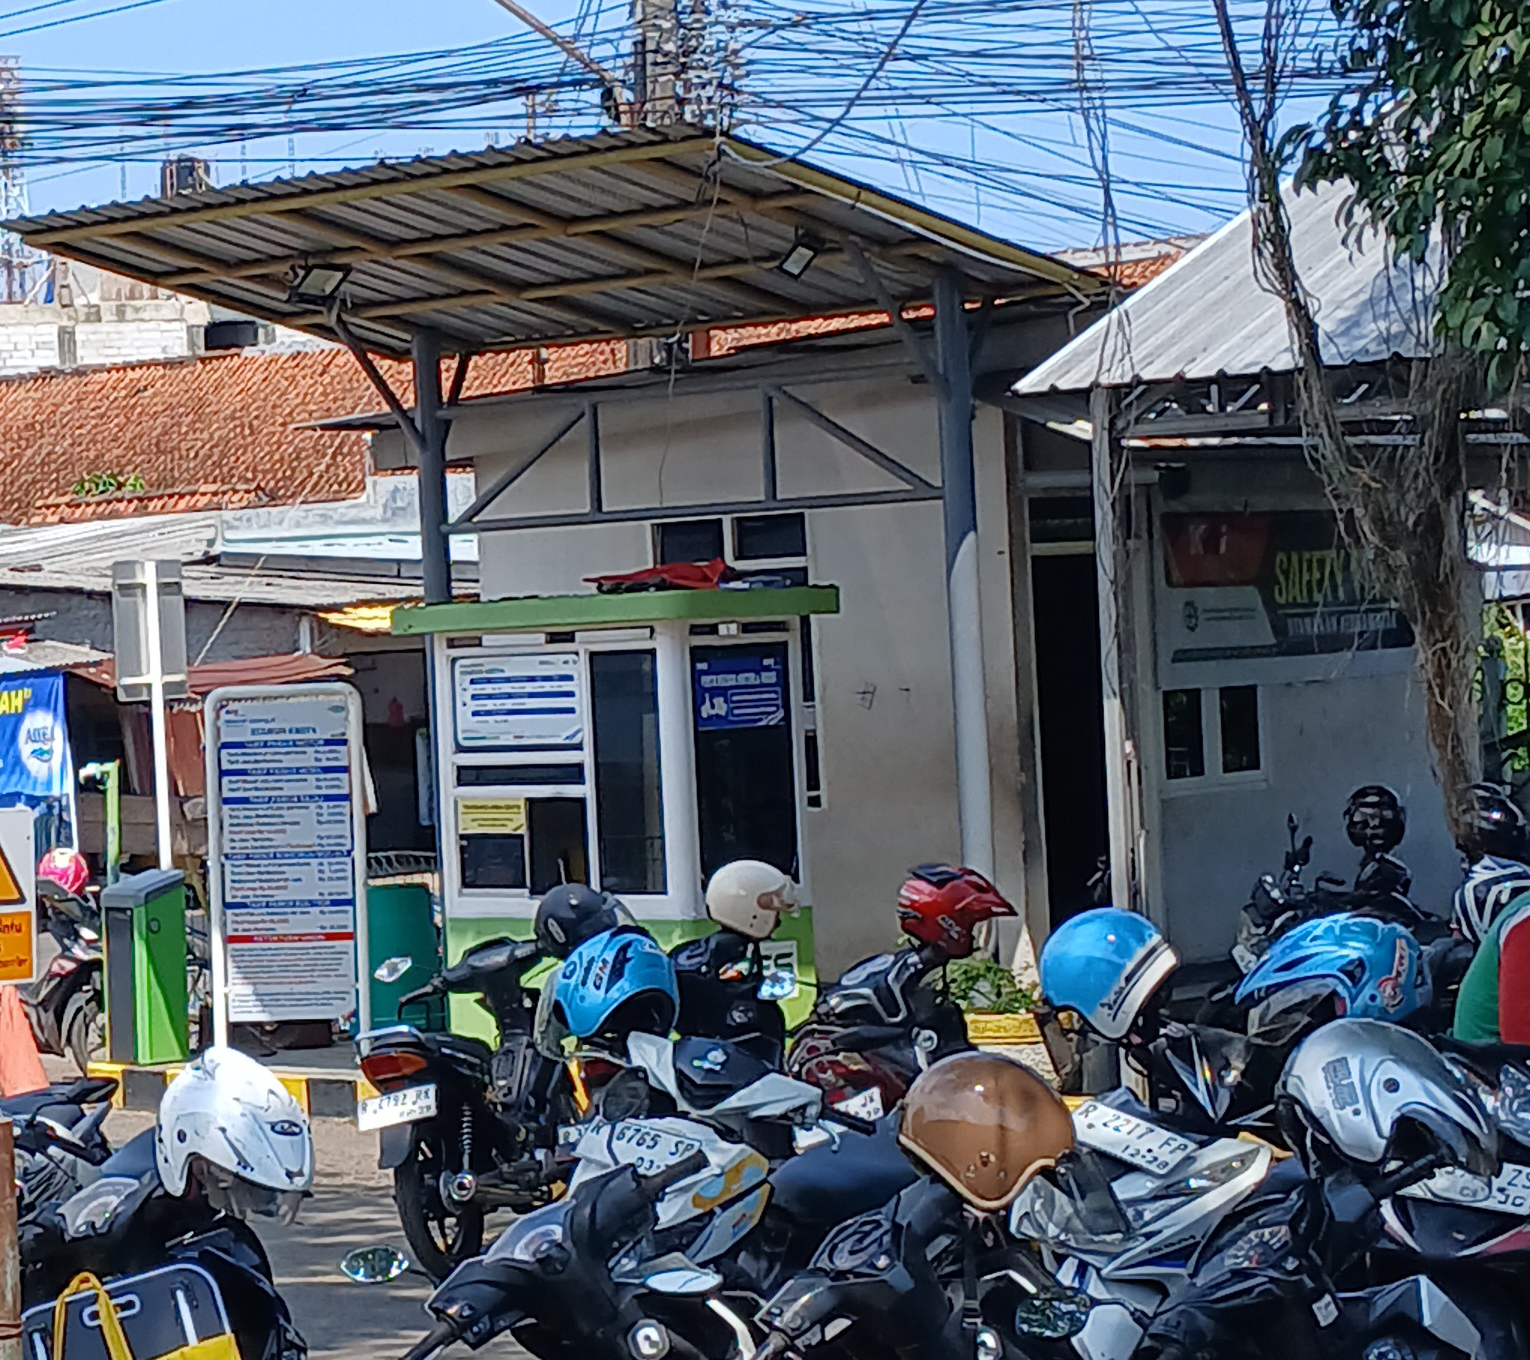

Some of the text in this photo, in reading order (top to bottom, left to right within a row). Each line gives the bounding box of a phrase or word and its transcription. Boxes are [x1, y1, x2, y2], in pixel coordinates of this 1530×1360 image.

[1078, 1104, 1098, 1118] R
[616, 1125, 662, 1150] 6765
[669, 1139, 695, 1157] SP
